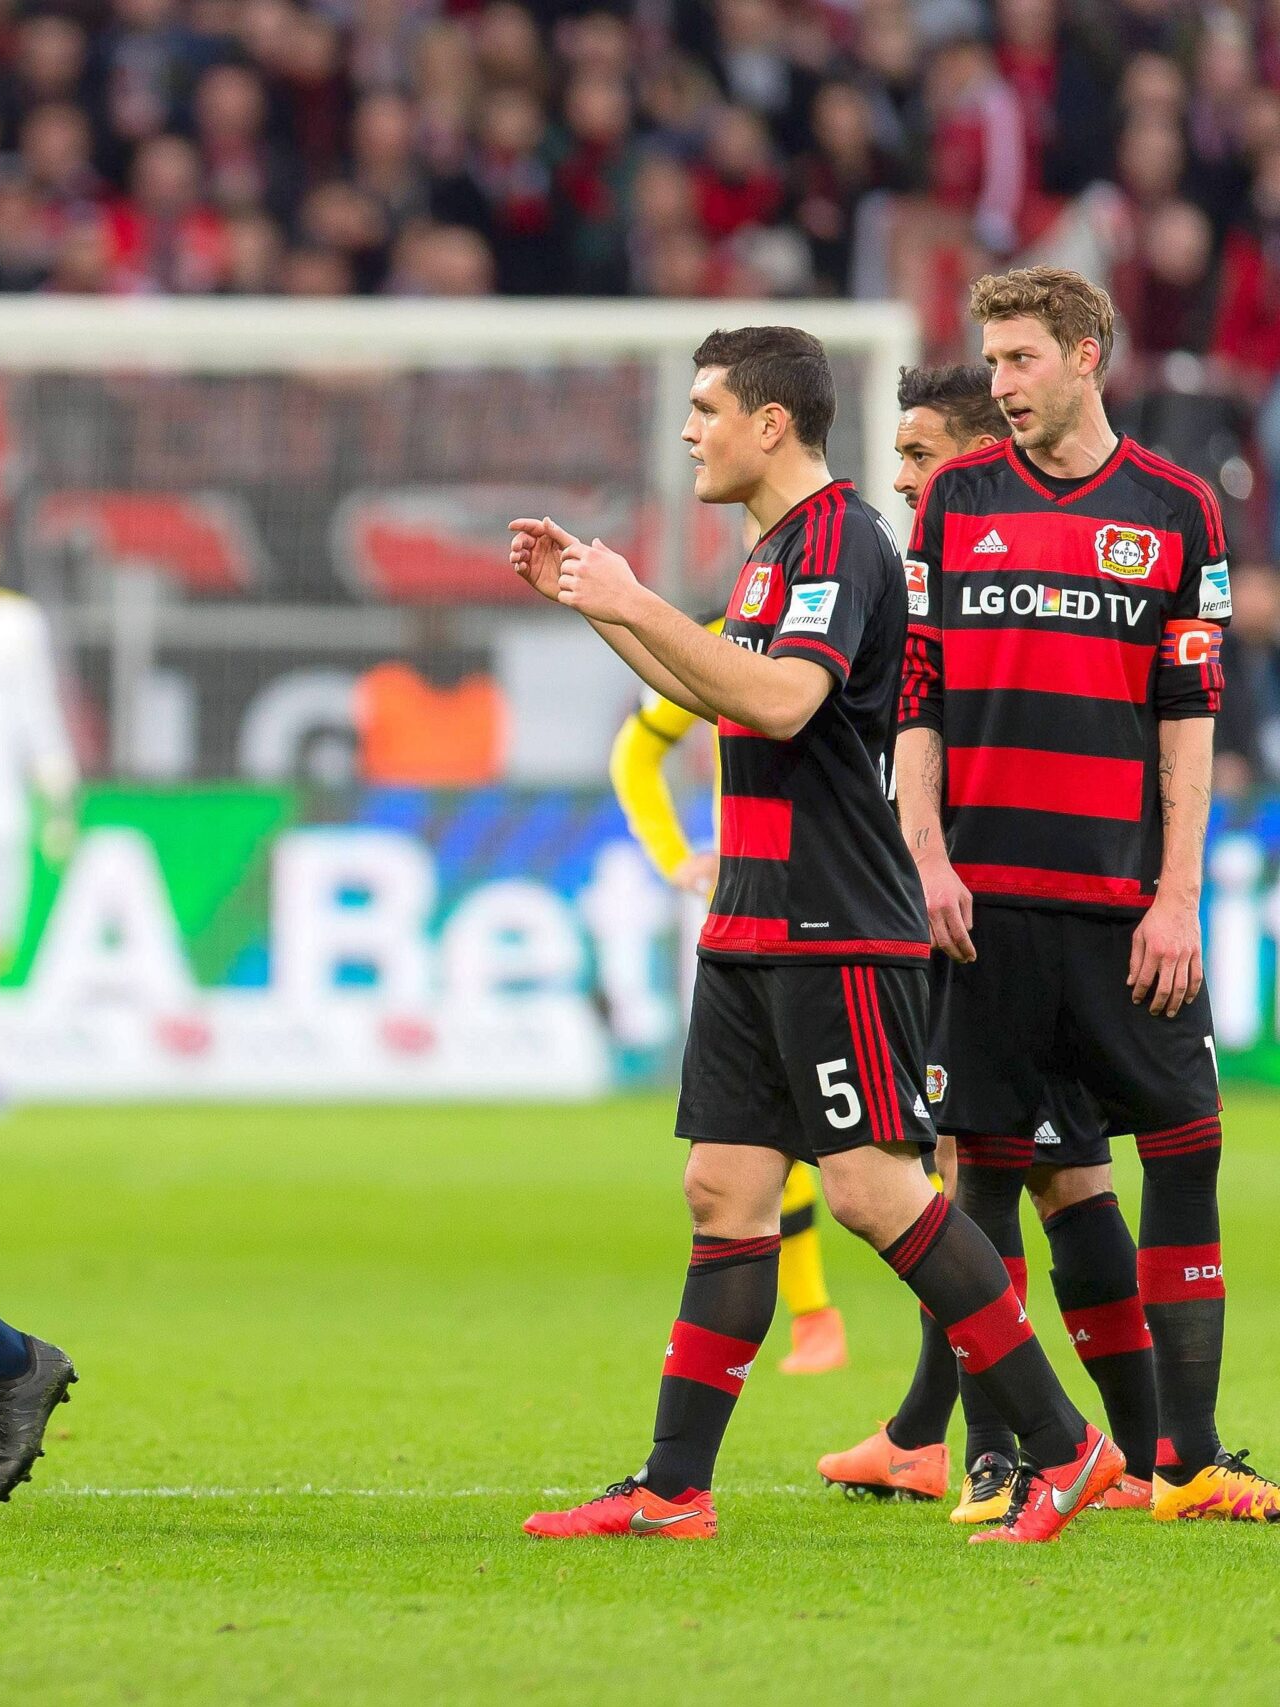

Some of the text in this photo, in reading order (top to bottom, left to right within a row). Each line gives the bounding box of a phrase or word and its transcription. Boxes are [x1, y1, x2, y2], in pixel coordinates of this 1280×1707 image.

[973, 544, 1008, 553] adidas
[1105, 562, 1143, 574] Leverkusen
[962, 583, 1148, 627] LG OLED TV
[786, 614, 829, 627] Hermes
[1178, 631, 1210, 665] C
[816, 1058, 862, 1129] 5
